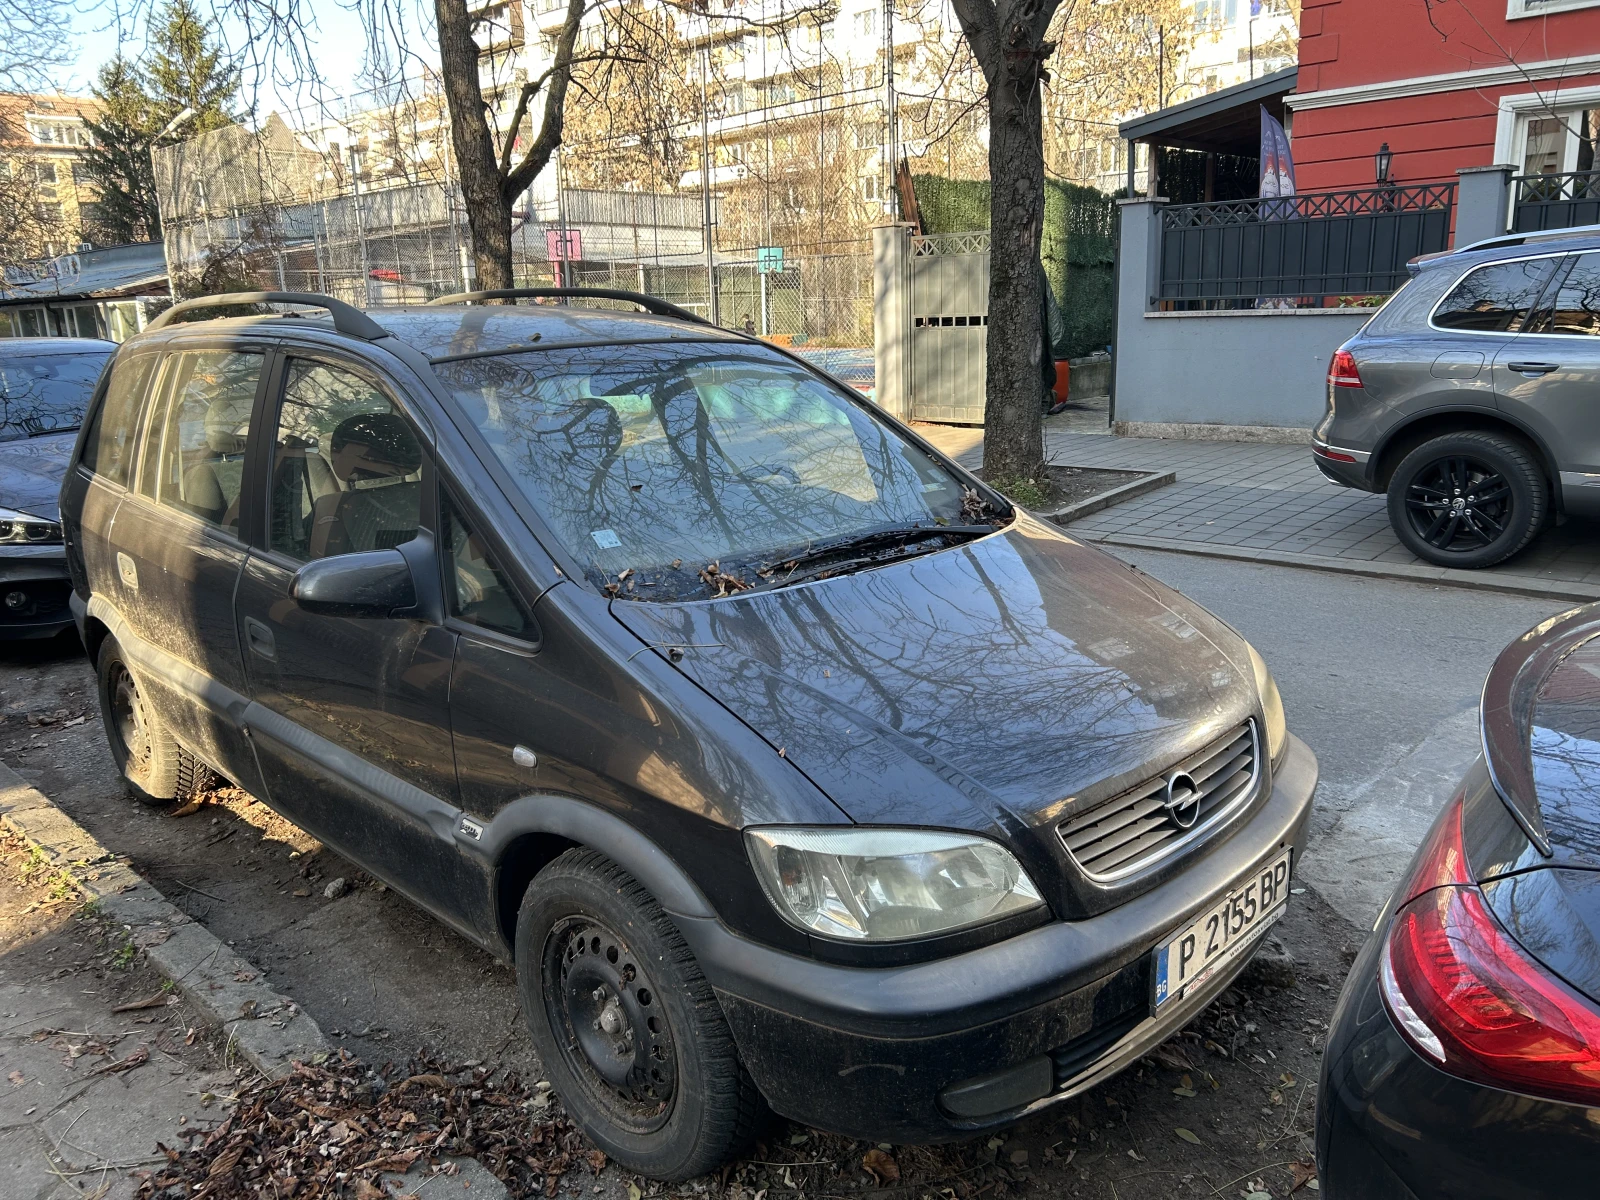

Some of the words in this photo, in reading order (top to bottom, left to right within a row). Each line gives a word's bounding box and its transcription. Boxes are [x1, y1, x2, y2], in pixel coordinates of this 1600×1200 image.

[1179, 933, 1196, 981] P
[1205, 881, 1257, 959] 2155
[1260, 860, 1287, 914] BP
[1156, 979, 1167, 998] BG
